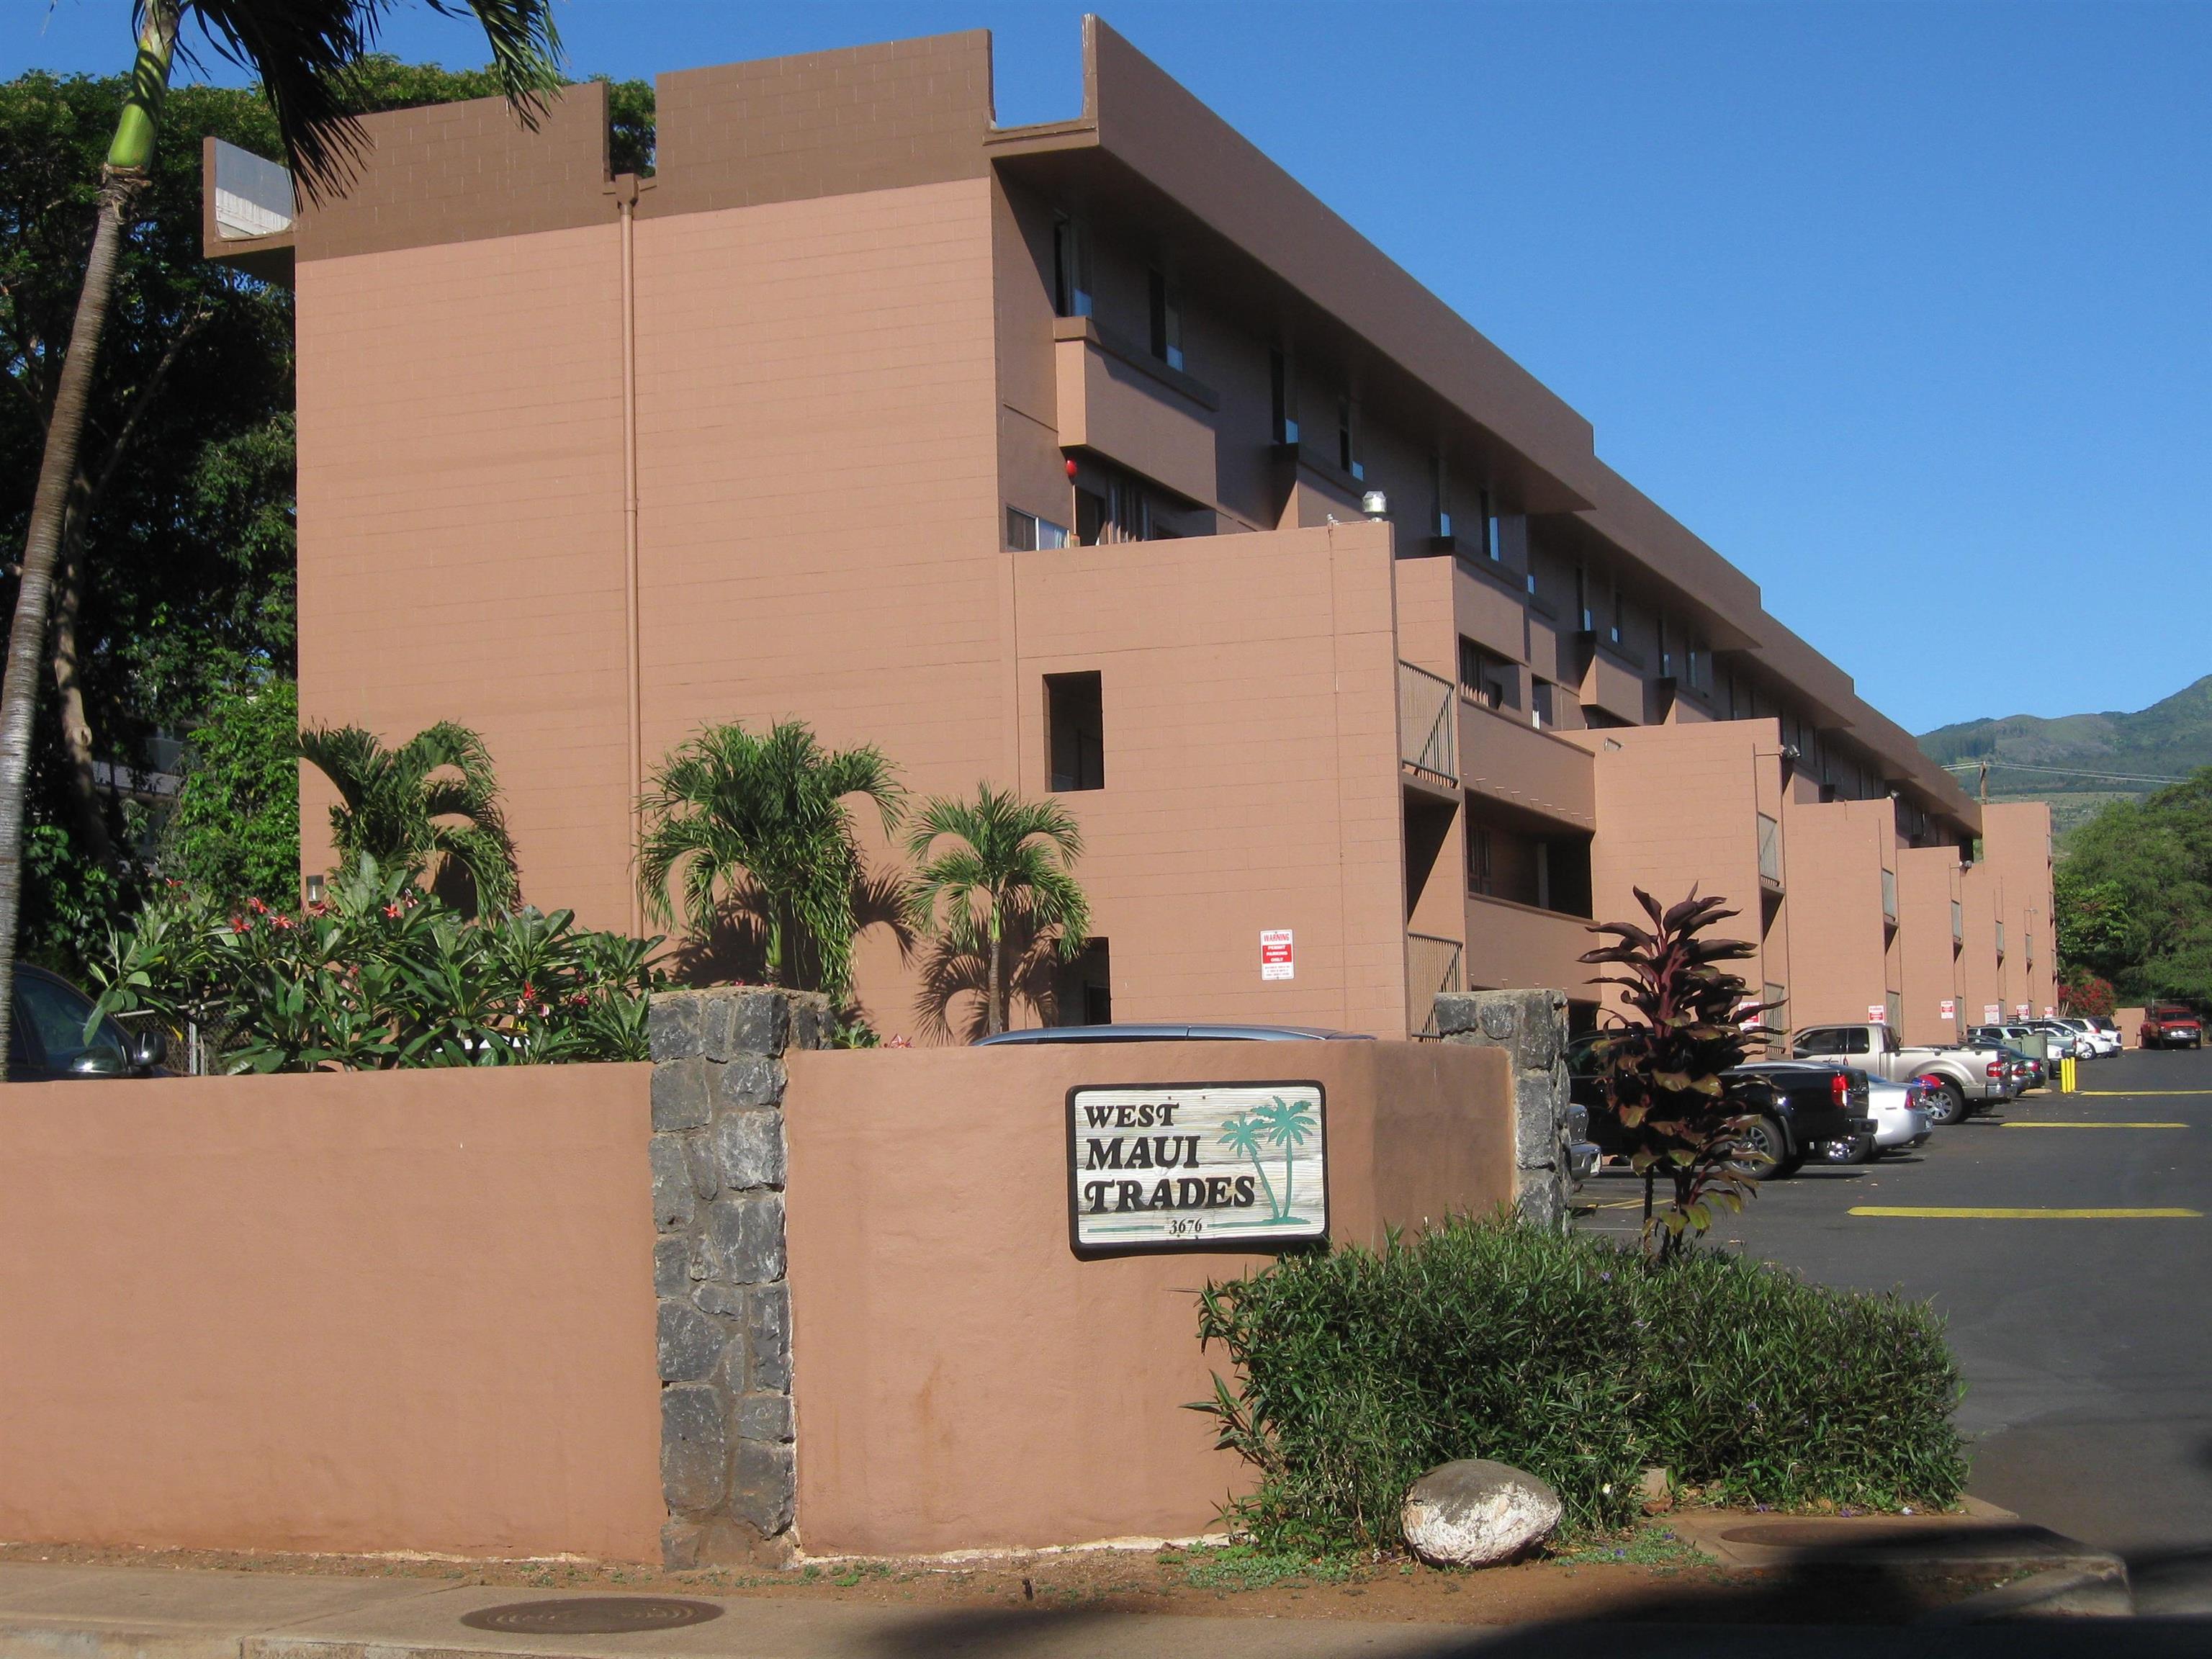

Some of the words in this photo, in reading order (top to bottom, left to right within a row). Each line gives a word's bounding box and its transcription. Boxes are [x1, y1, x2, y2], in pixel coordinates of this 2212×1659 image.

[1264, 933, 1290, 942] WARNING
[1084, 1102, 1179, 1128] WEST
[1085, 1136, 1201, 1170] MAUI
[1084, 1176, 1255, 1212] TRADES
[1169, 1217, 1202, 1234] 3676
